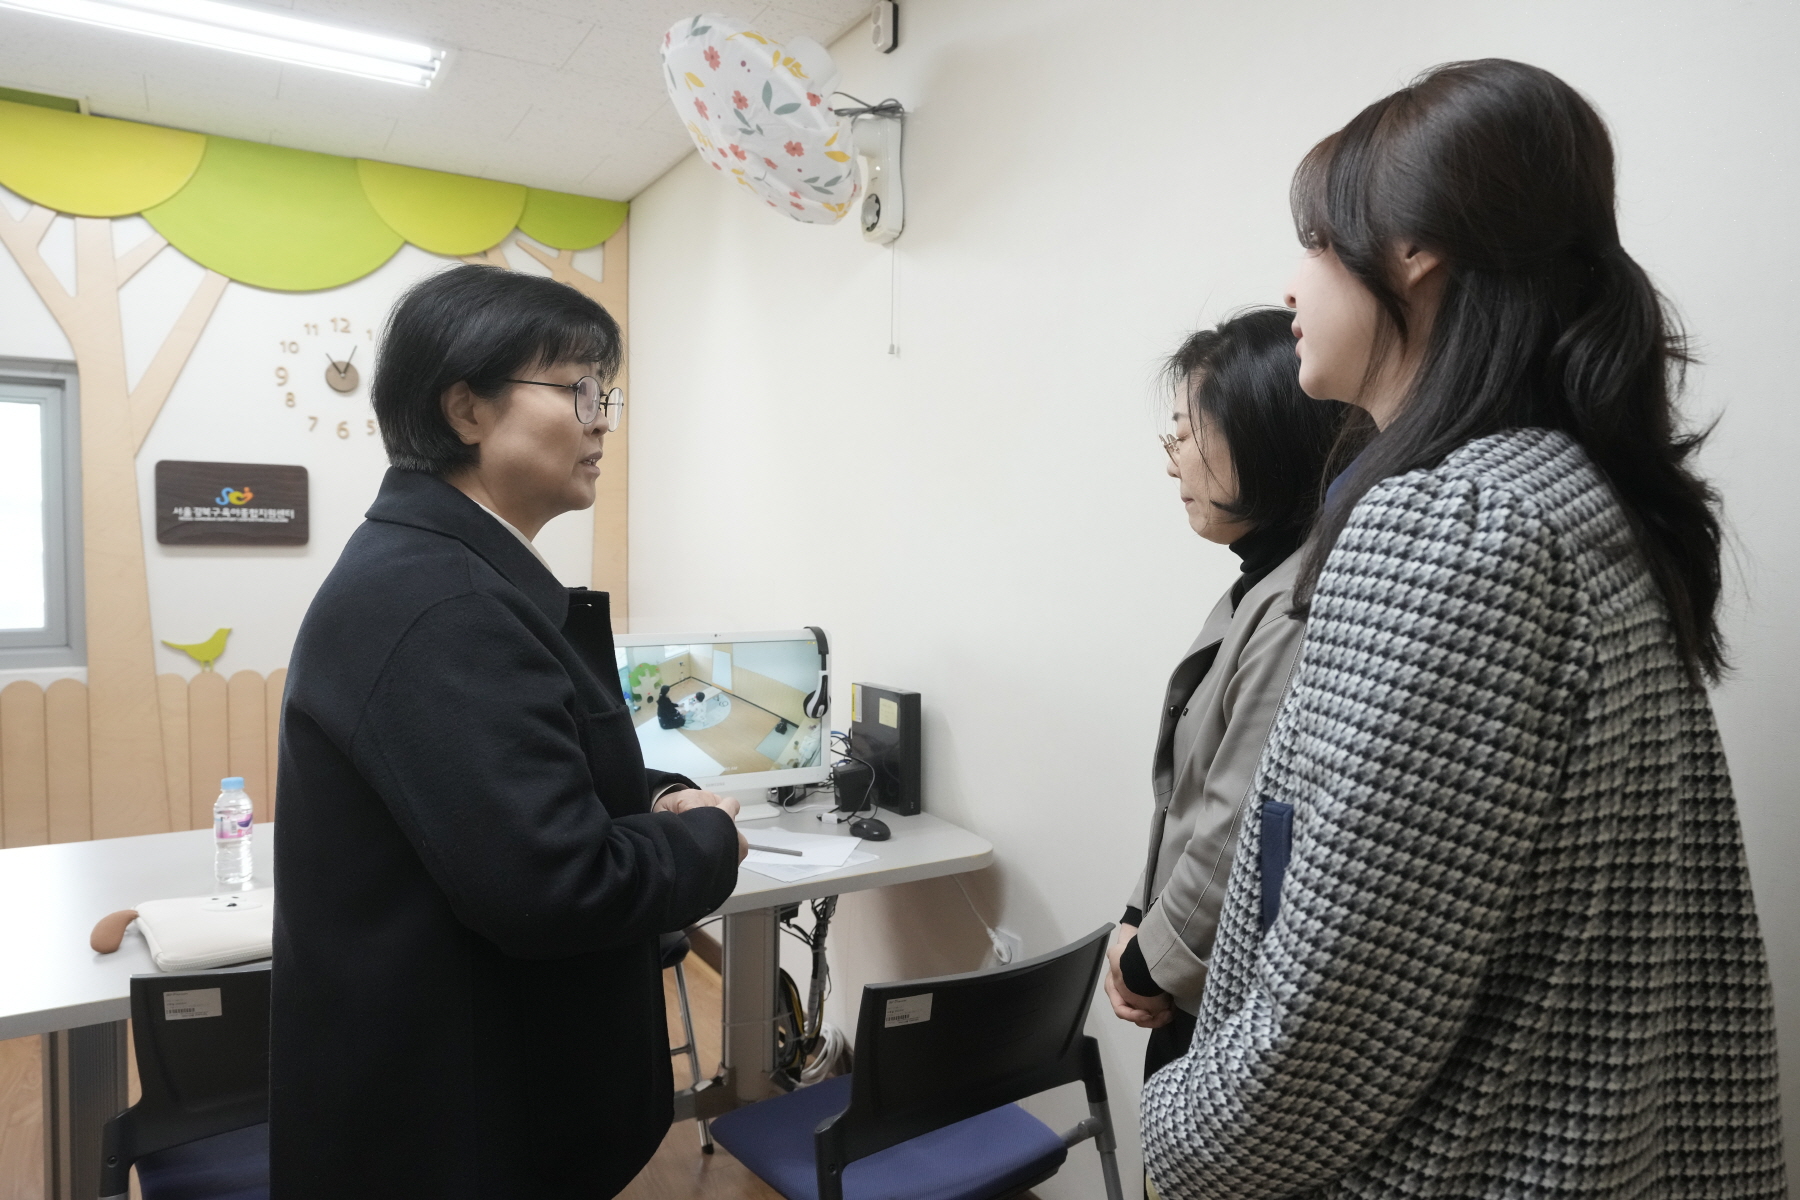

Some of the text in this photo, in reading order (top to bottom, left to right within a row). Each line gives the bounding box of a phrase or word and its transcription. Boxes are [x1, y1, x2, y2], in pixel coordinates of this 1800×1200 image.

[304, 323, 319, 336] 11
[330, 317, 351, 334] 12
[366, 328, 373, 341] 1
[279, 340, 300, 354] 10
[275, 366, 289, 387] 9
[285, 392, 296, 408] 8
[308, 416, 318, 432] 7
[336, 421, 350, 440] 6
[366, 419, 376, 436] 5
